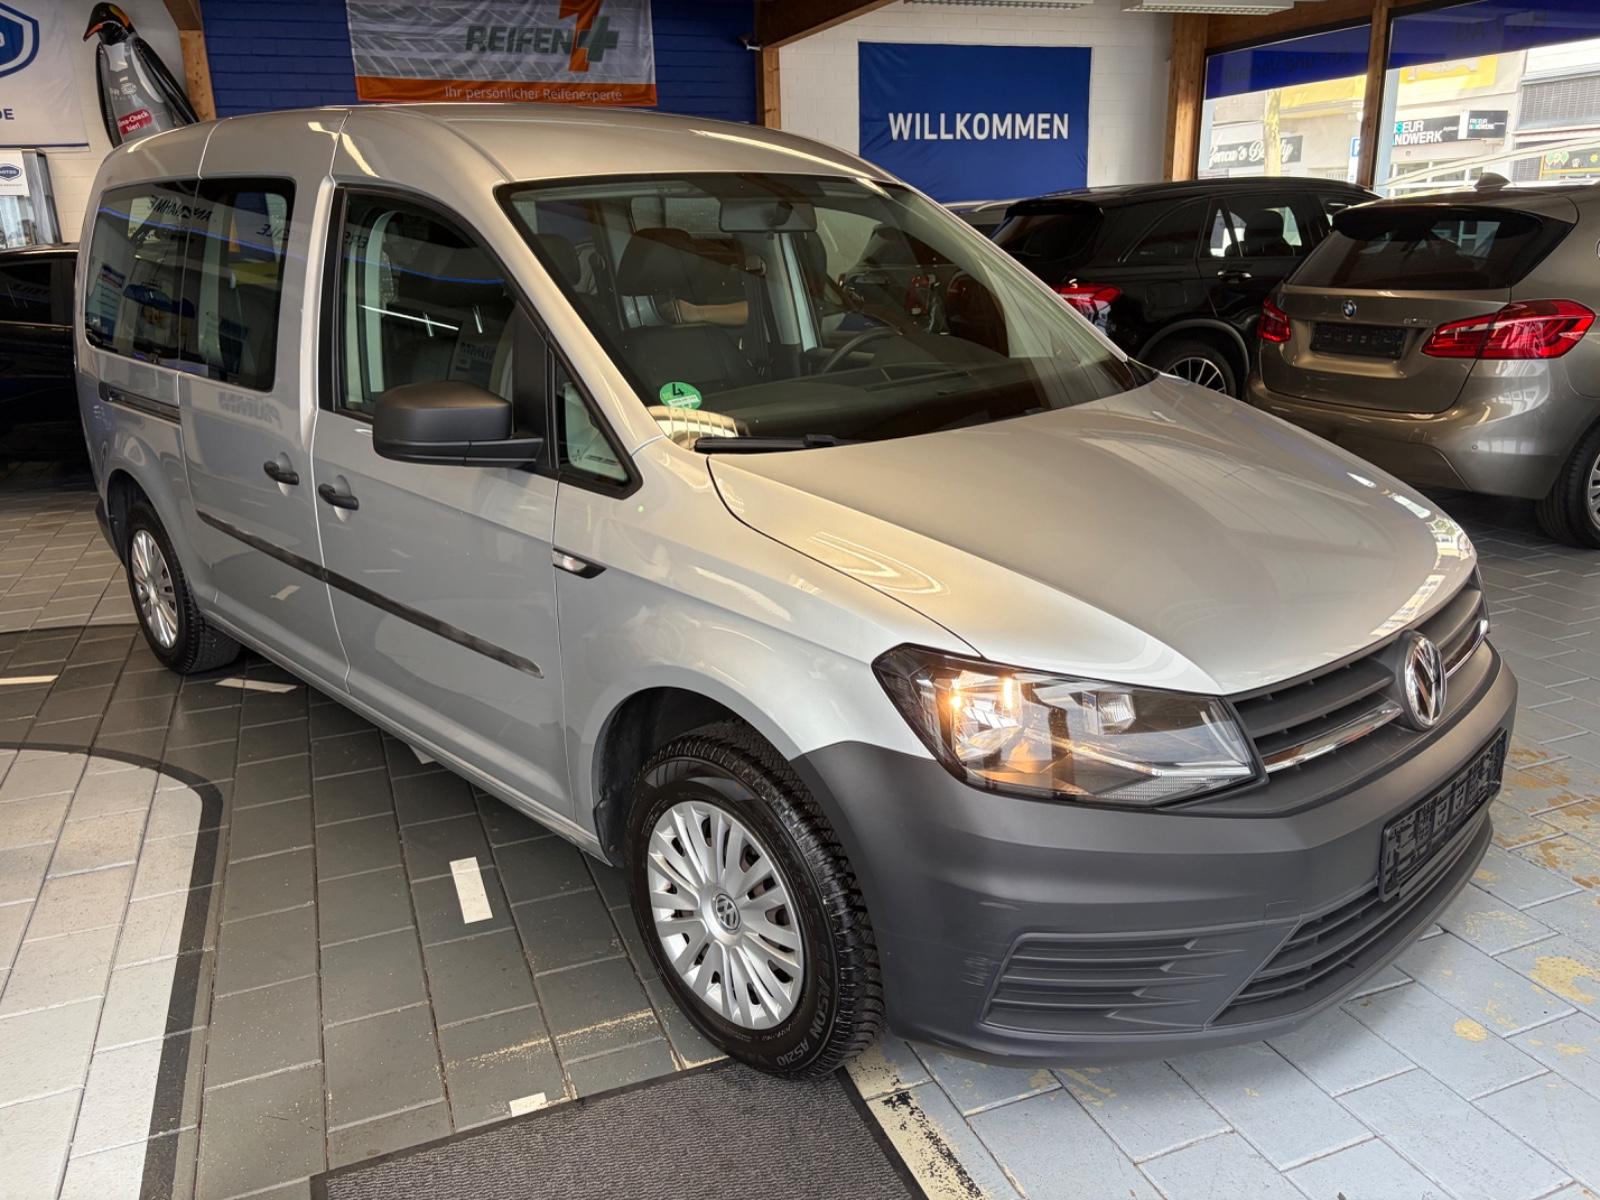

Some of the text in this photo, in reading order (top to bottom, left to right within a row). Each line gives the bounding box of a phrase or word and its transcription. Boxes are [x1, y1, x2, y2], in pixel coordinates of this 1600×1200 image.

[445, 86, 462, 97] Ihr
[543, 88, 623, 102] Reifenexperte
[888, 112, 1069, 140] WILLKOMMEN
[671, 383, 685, 396] 4
[776, 1038, 809, 1066] AS210
